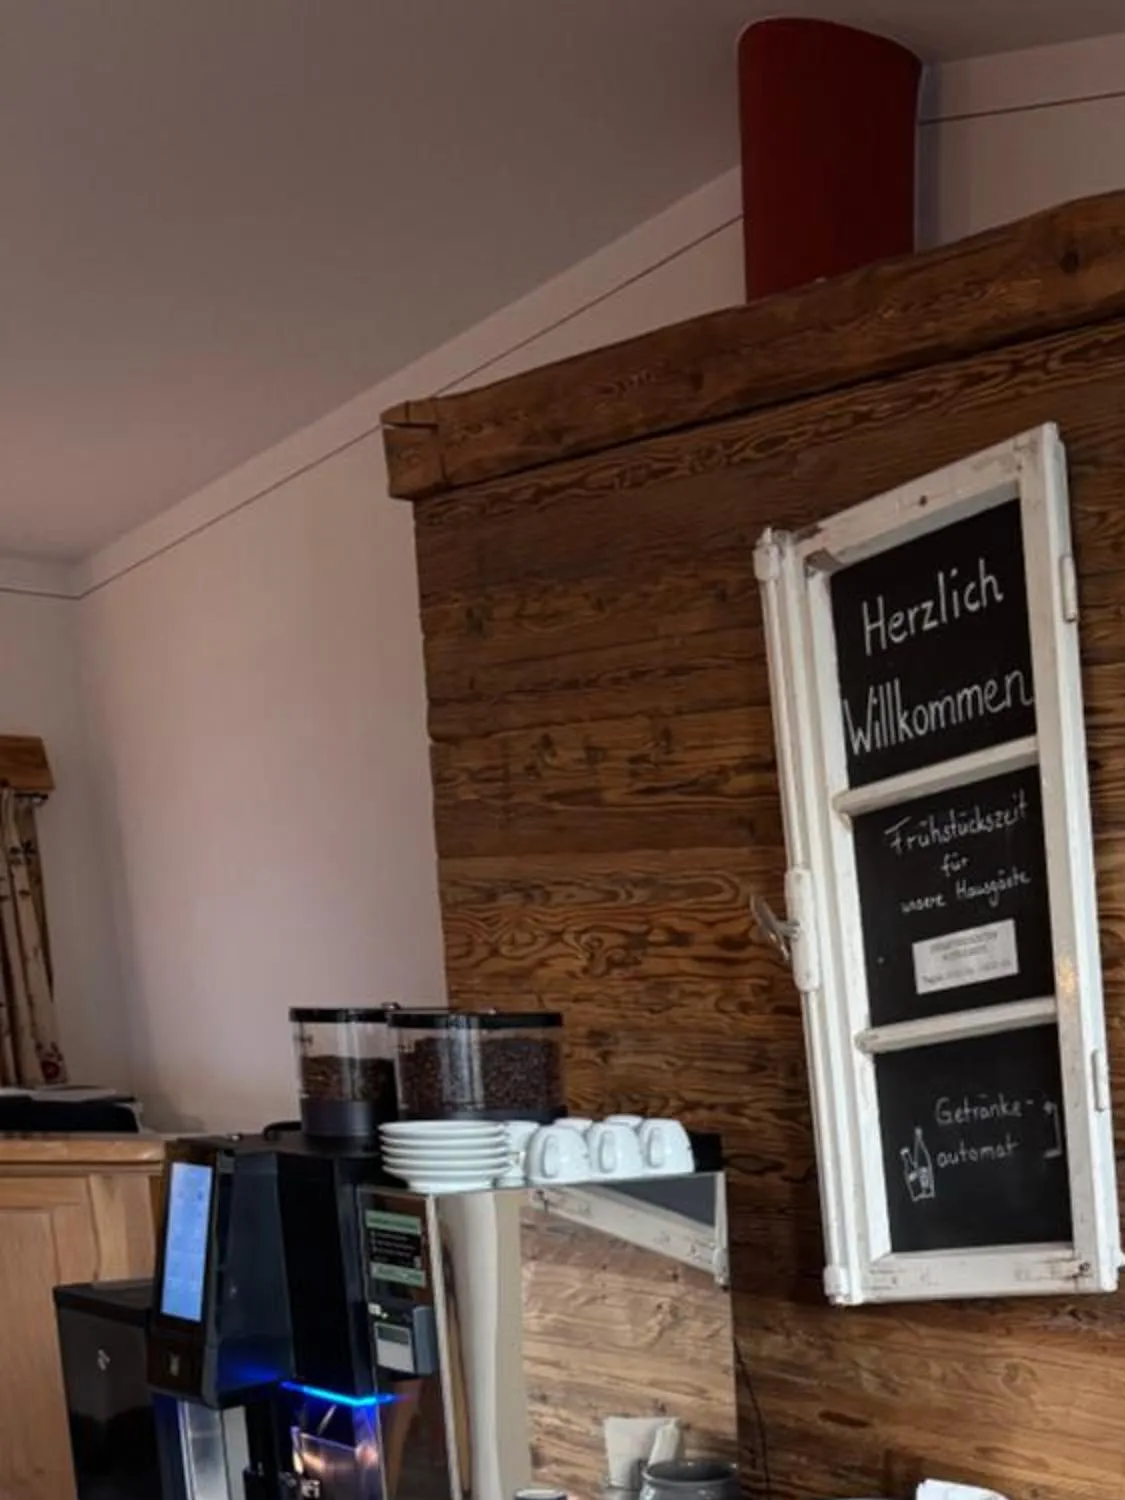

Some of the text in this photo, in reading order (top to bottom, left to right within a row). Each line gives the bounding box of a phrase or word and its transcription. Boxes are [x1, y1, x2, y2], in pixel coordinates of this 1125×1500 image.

[862, 558, 1004, 656] Herzlich
[843, 669, 1034, 756] Willkommen
[884, 788, 1027, 854] Frühstückszeit
[901, 867, 1030, 913] unsere Hausgäste
[941, 852, 969, 877] für
[937, 1134, 1019, 1168] automat
